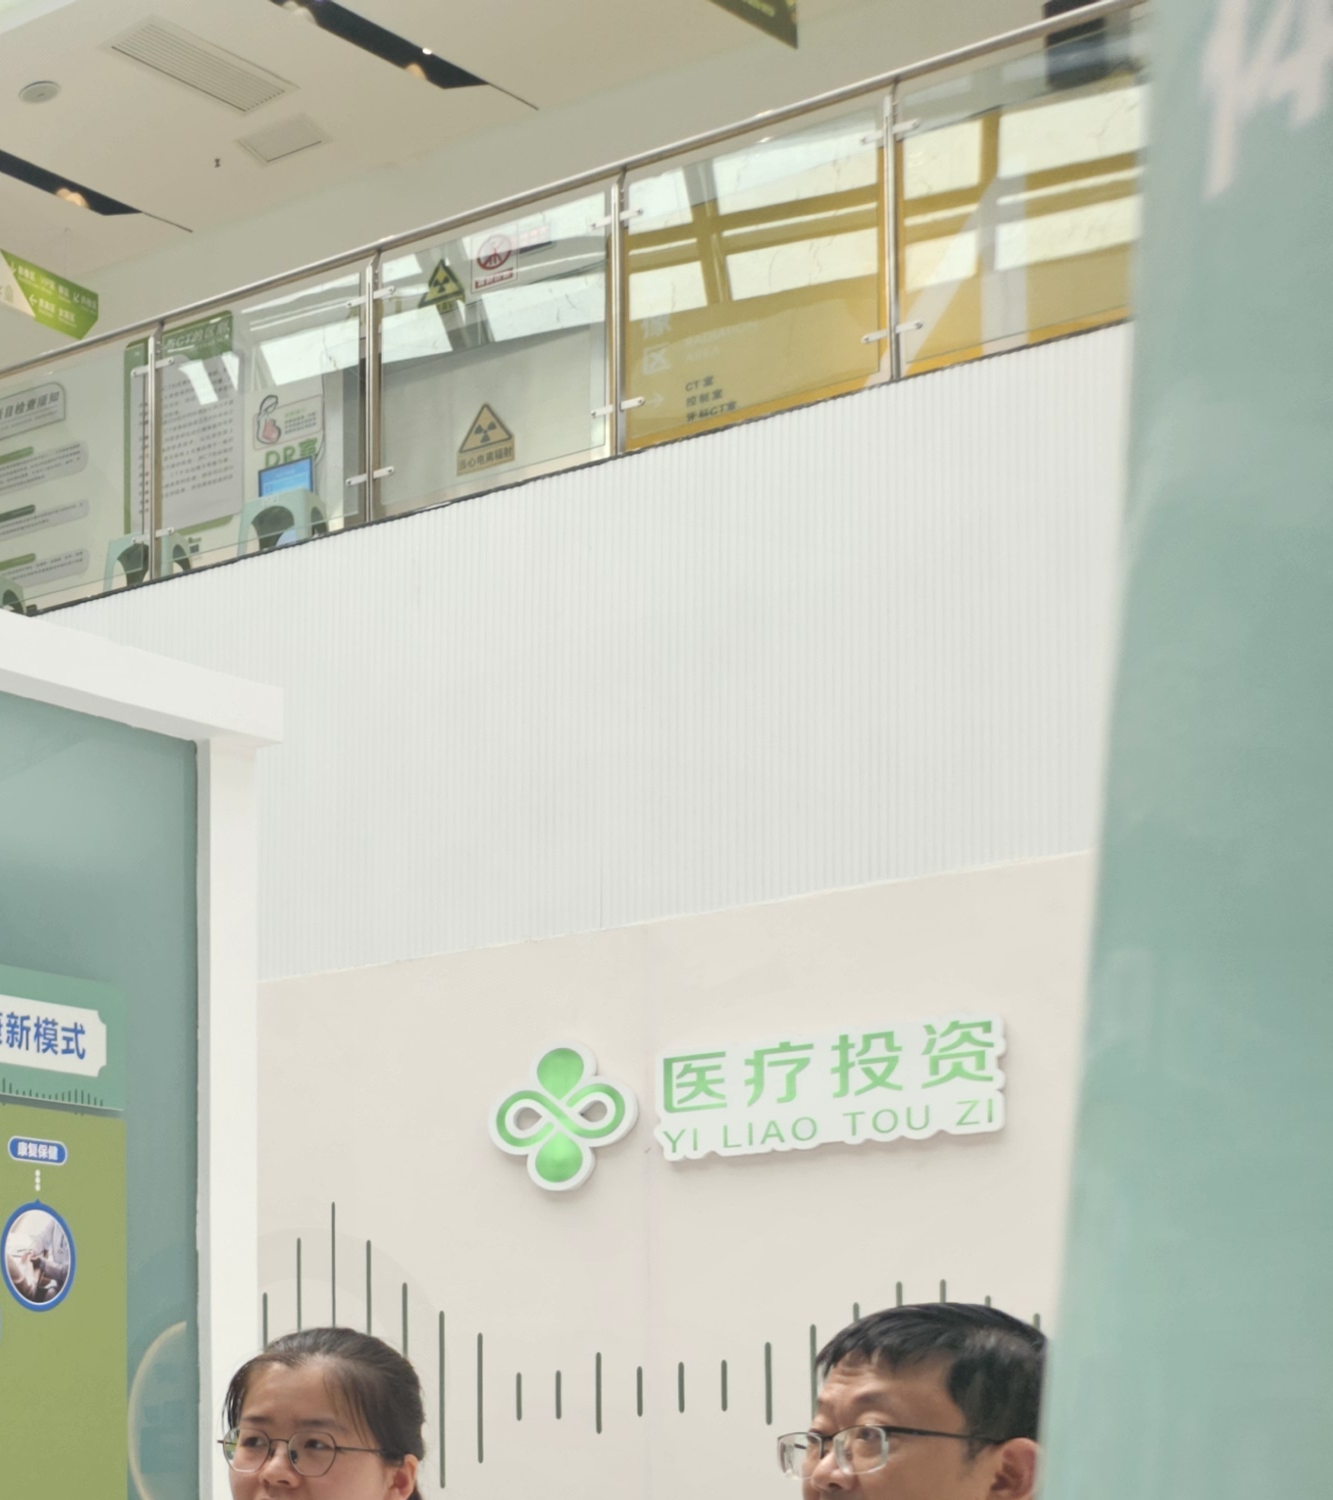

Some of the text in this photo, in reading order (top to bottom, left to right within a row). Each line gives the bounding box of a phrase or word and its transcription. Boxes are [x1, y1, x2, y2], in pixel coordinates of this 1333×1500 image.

[662, 1019, 994, 1114] 医疗投资
[662, 1098, 995, 1155] YI LIAO TOU ZI
